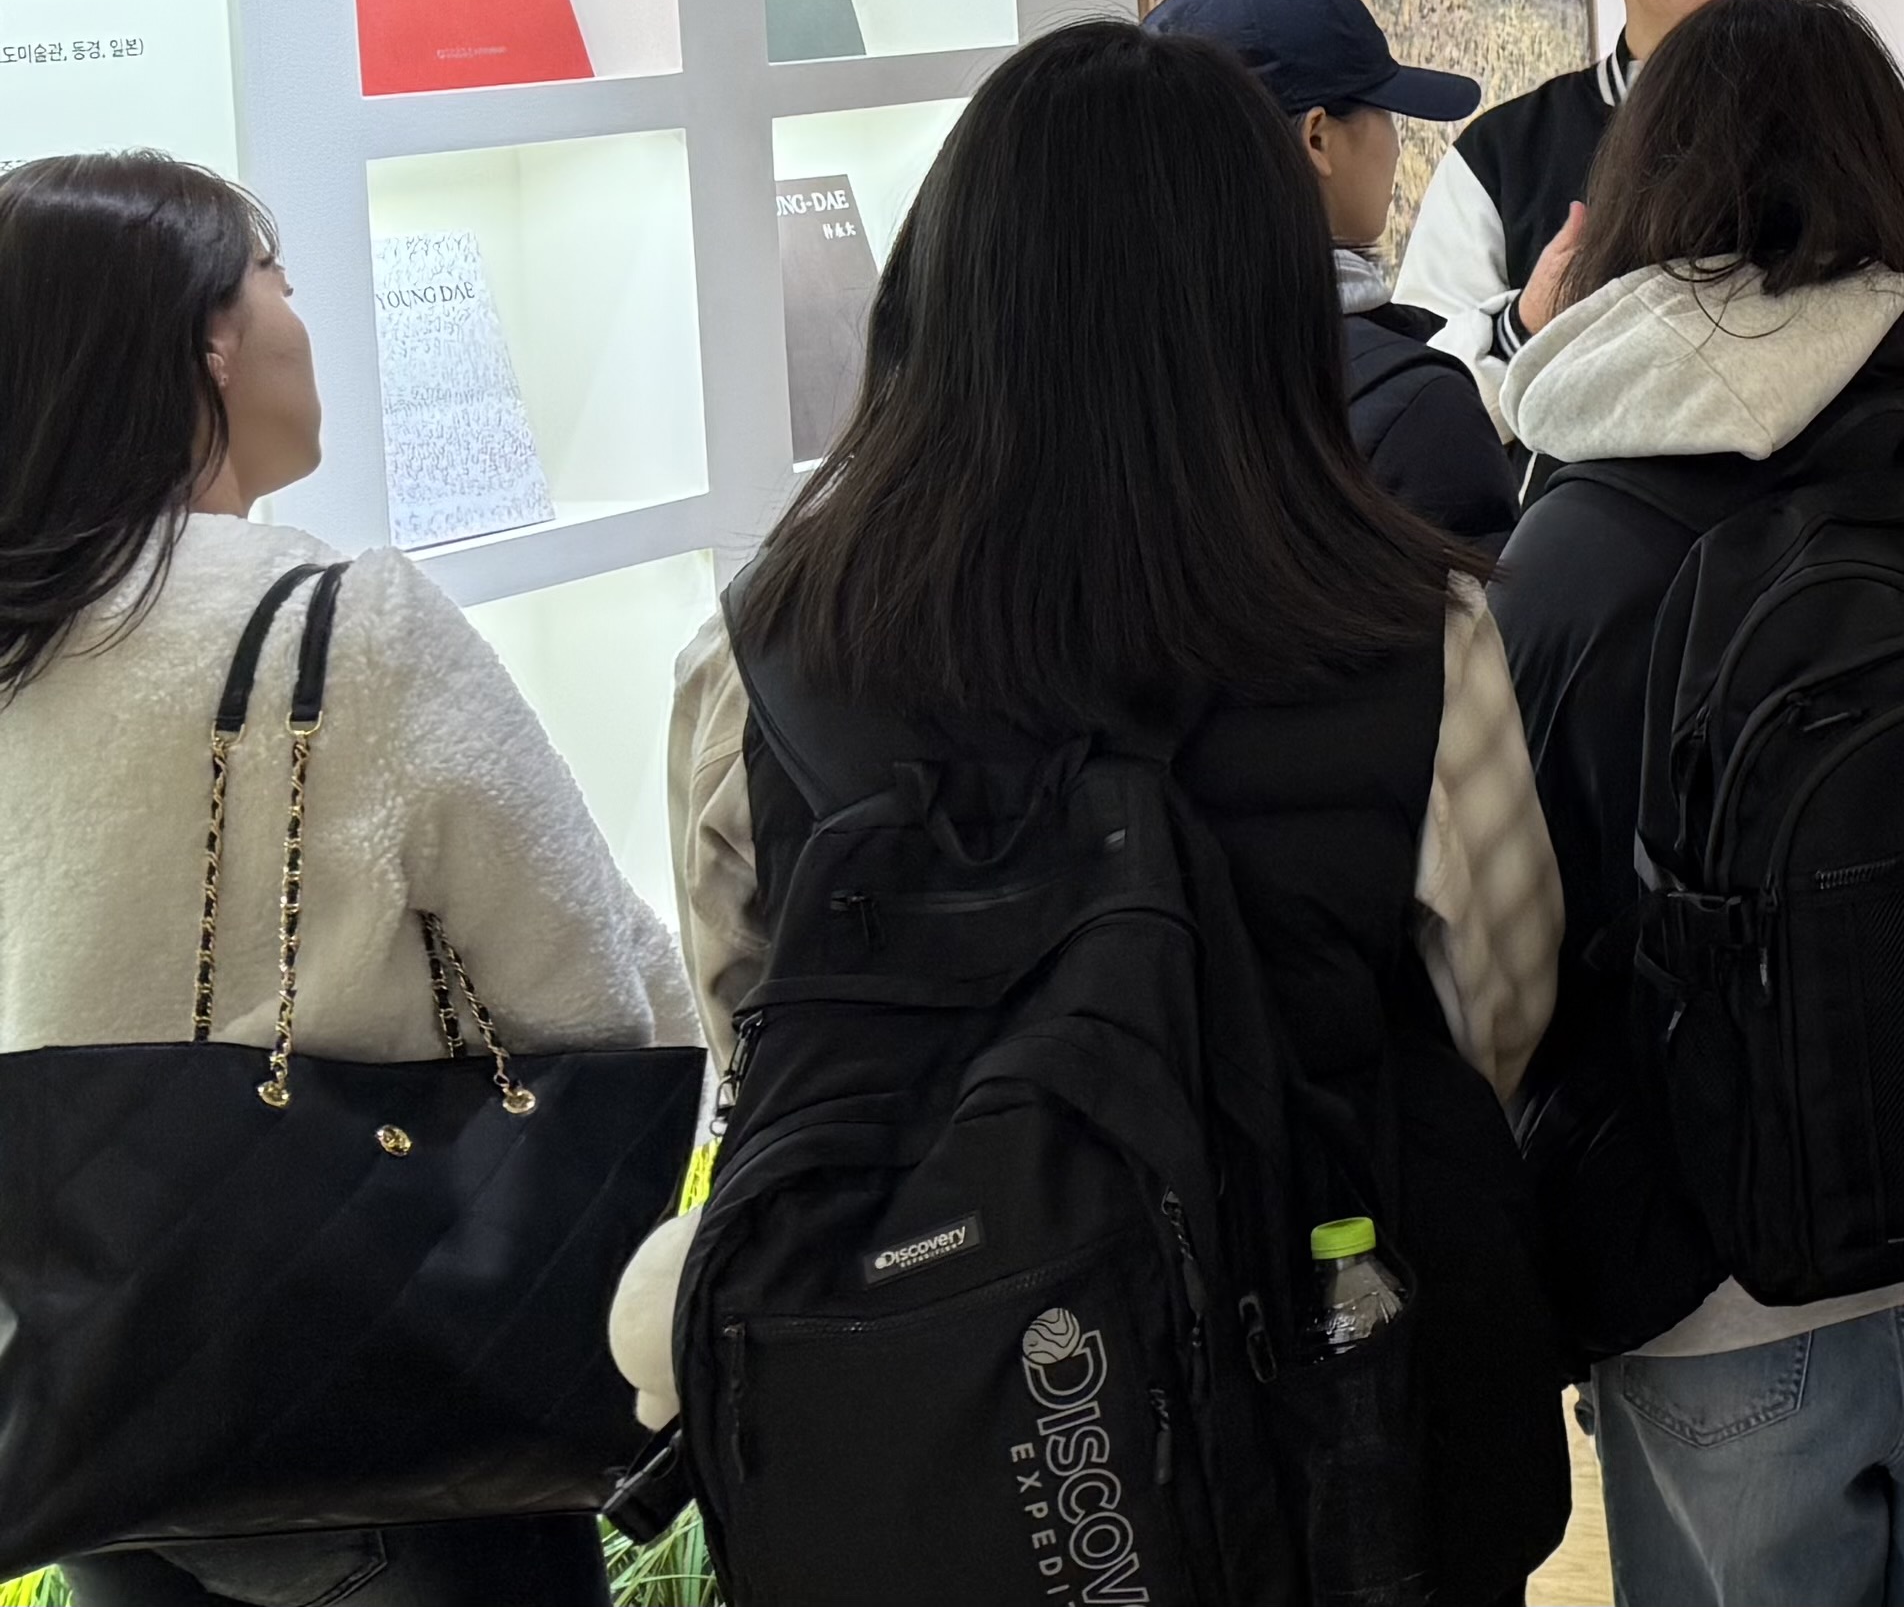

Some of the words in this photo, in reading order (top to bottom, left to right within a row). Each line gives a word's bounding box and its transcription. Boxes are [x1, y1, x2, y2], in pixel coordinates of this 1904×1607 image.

[110, 38, 144, 58] 일본)
[375, 286, 436, 310] YOUNG
[439, 281, 475, 303] DAE
[1009, 1442, 1076, 1607] EXPEDI
